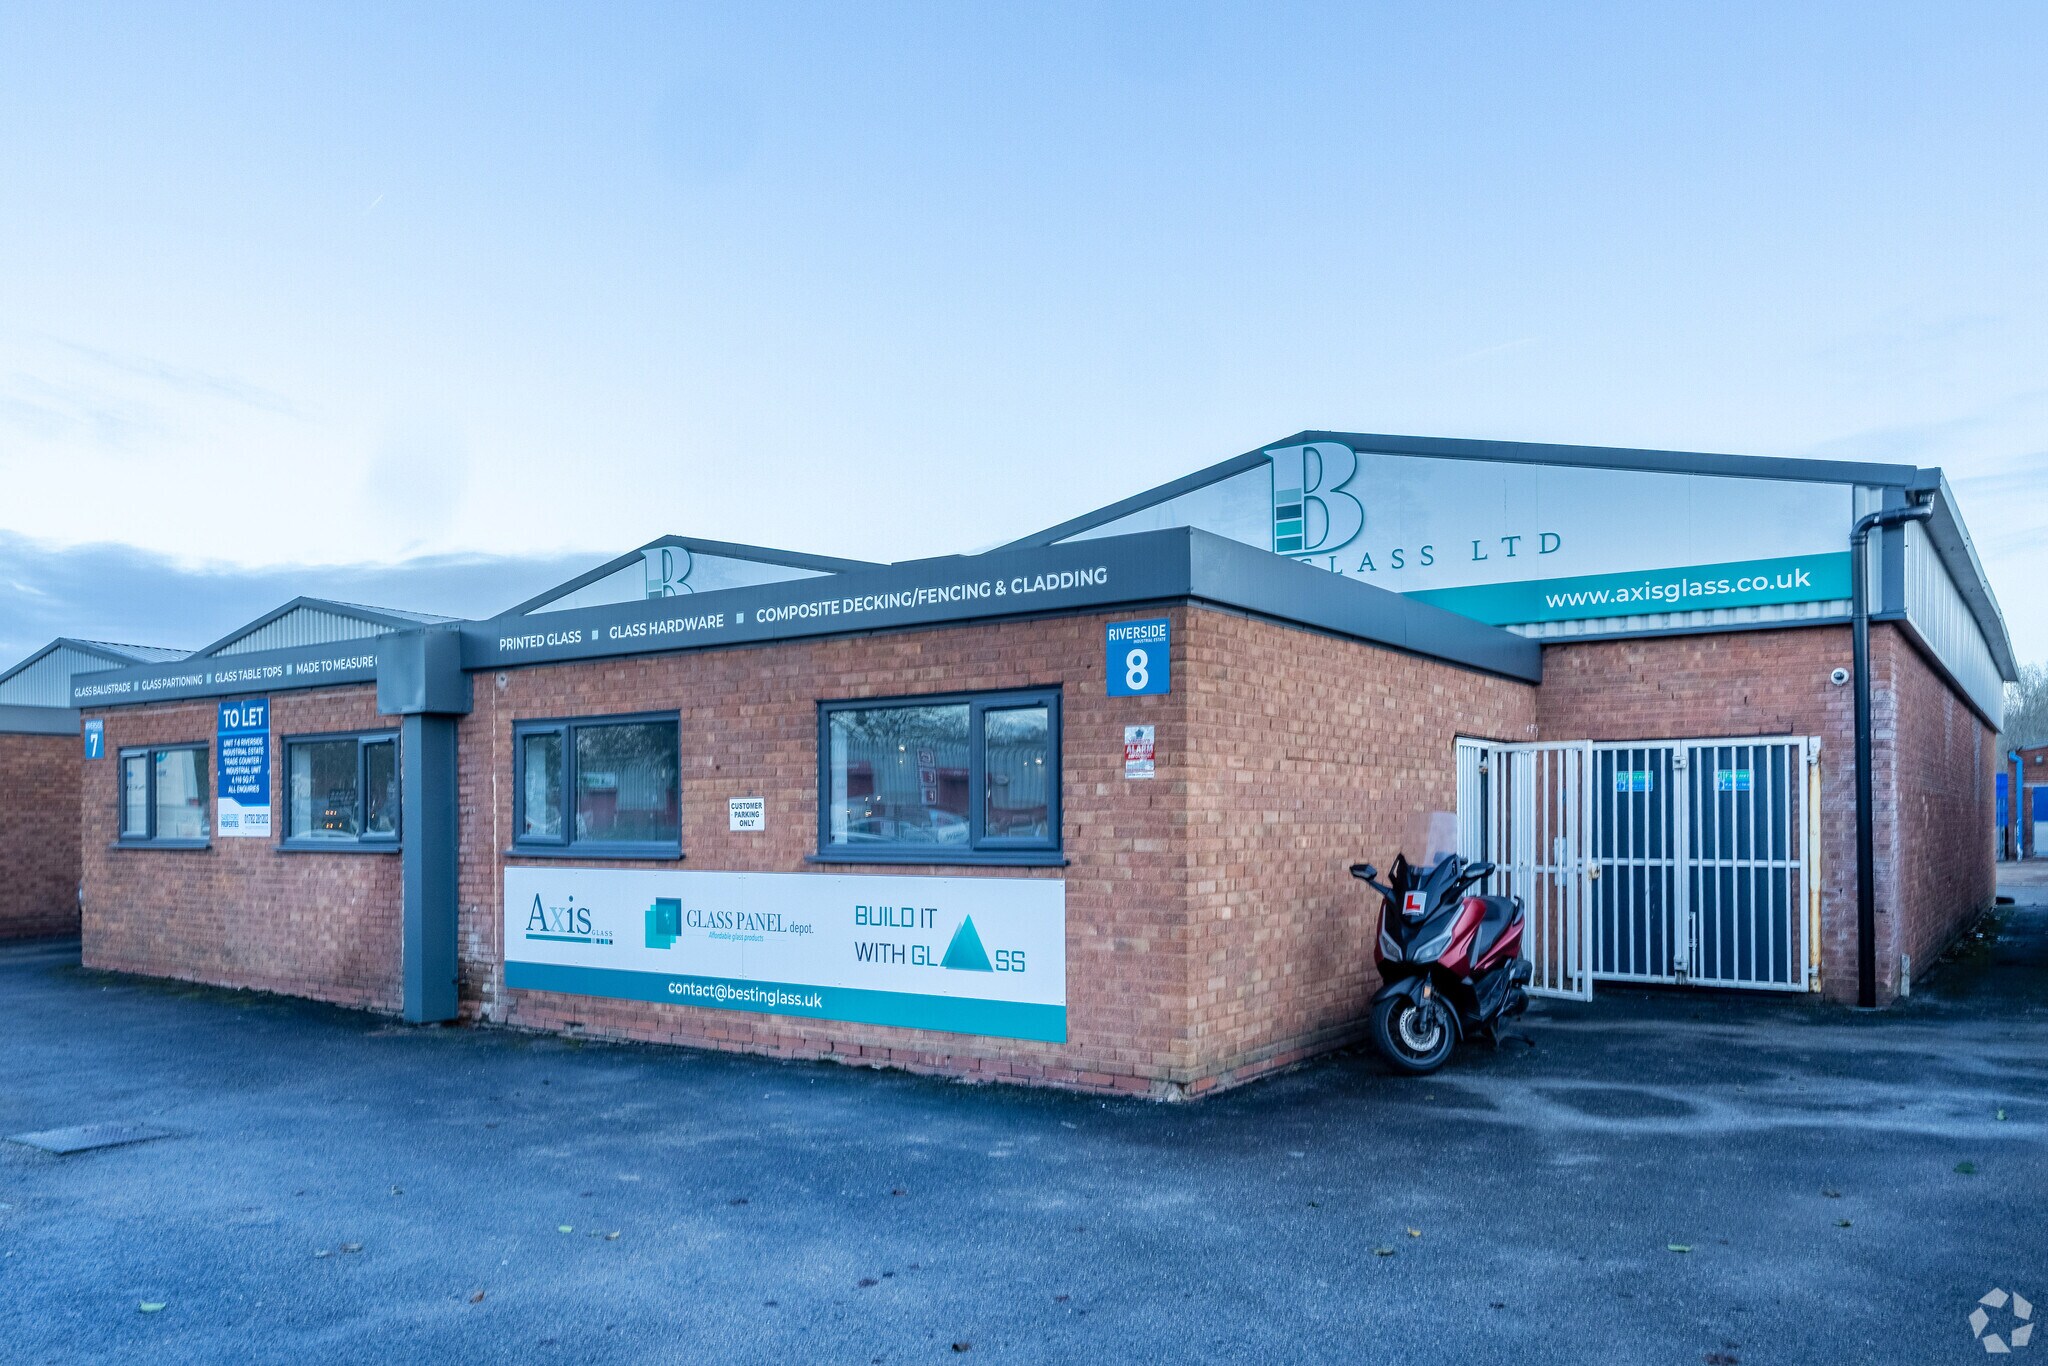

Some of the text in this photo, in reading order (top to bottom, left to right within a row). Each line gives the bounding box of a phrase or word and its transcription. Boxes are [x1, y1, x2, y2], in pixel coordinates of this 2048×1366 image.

[1264, 441, 1364, 556] B
[1472, 532, 1562, 562] LTD
[756, 566, 1108, 624] COMPOSITE DECKING/FENCING & CLADDING
[1546, 567, 1811, 609] www.axisglass.co.uk
[609, 613, 724, 639] GLASS HARDWARE
[1109, 624, 1166, 641] RIVERSIDE
[499, 629, 582, 651] PRINTED GLASS
[215, 664, 283, 683] GLASS TABLE TOPS
[296, 660, 320, 675] MADE
[320, 659, 332, 673] TO
[333, 655, 374, 671] MEASURE
[1126, 648, 1149, 691] 8
[74, 681, 131, 697] GLASS BALUSTRADE
[141, 673, 203, 691] GLASS PARTIONING
[223, 706, 264, 729] TO LET
[90, 733, 98, 757] 7
[525, 892, 592, 935] Axis
[1406, 894, 1420, 911] L
[686, 909, 814, 936] GLASS PANEL depot.
[855, 905, 938, 928] BUILD IT
[708, 931, 764, 942] Affordable glass products
[854, 941, 906, 965] WITH
[668, 980, 822, 1009] contact@bestinglass.uk
